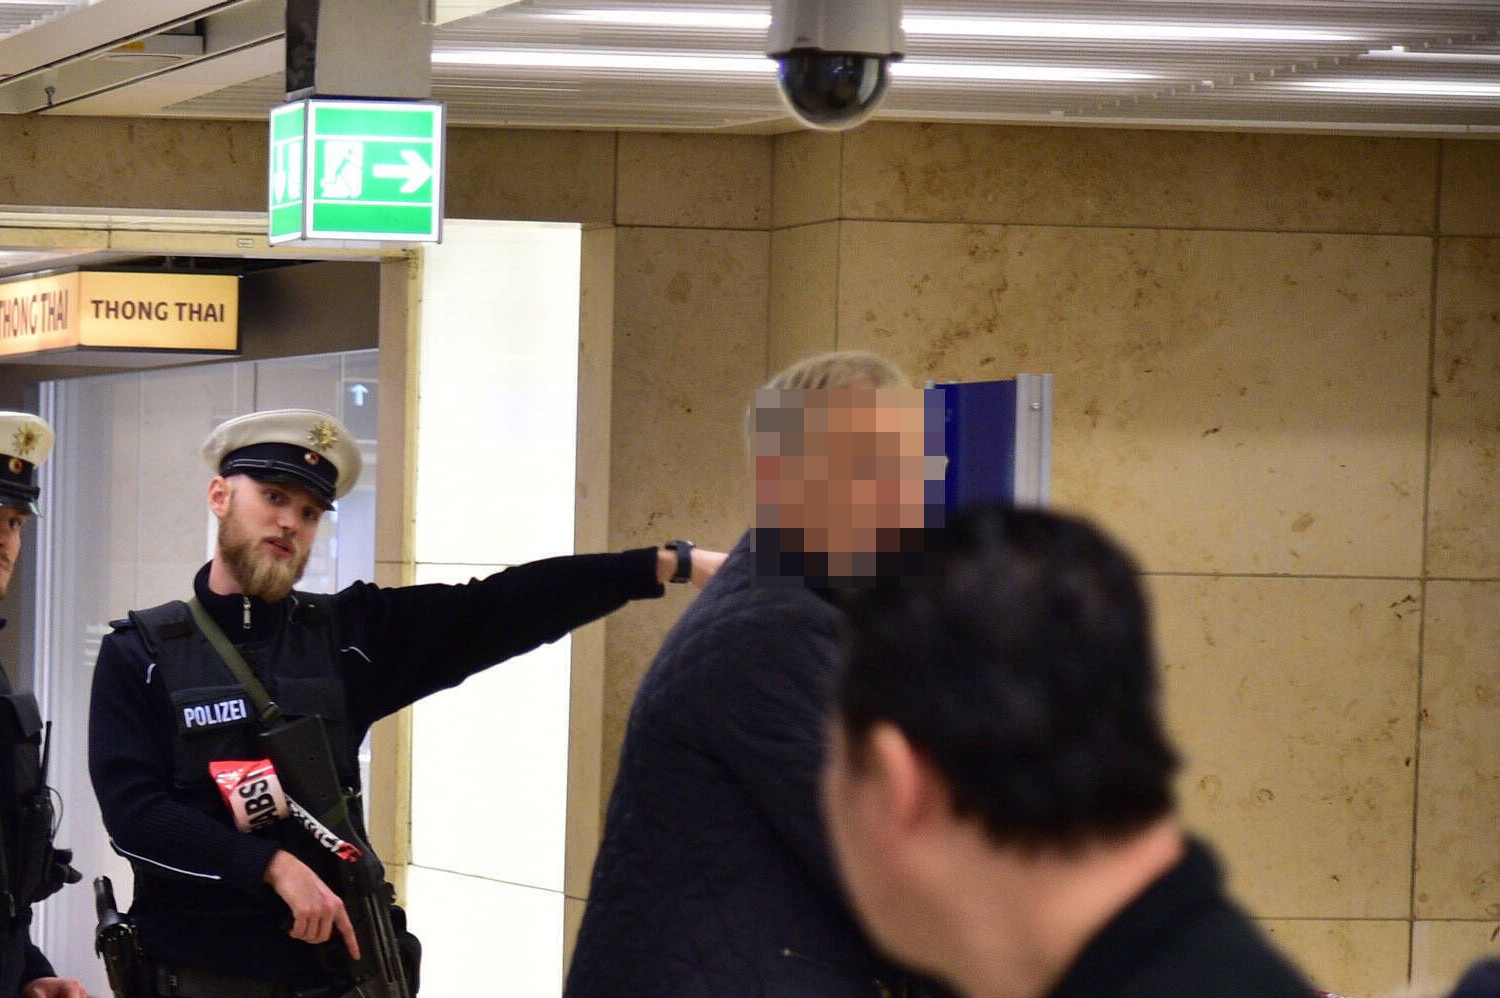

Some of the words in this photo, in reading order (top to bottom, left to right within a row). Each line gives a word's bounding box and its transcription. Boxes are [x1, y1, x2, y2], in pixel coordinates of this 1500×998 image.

[40, 289, 68, 333] THAI
[91, 300, 168, 322] THONG
[175, 302, 225, 323] THAI
[183, 699, 247, 728] POLIZEI
